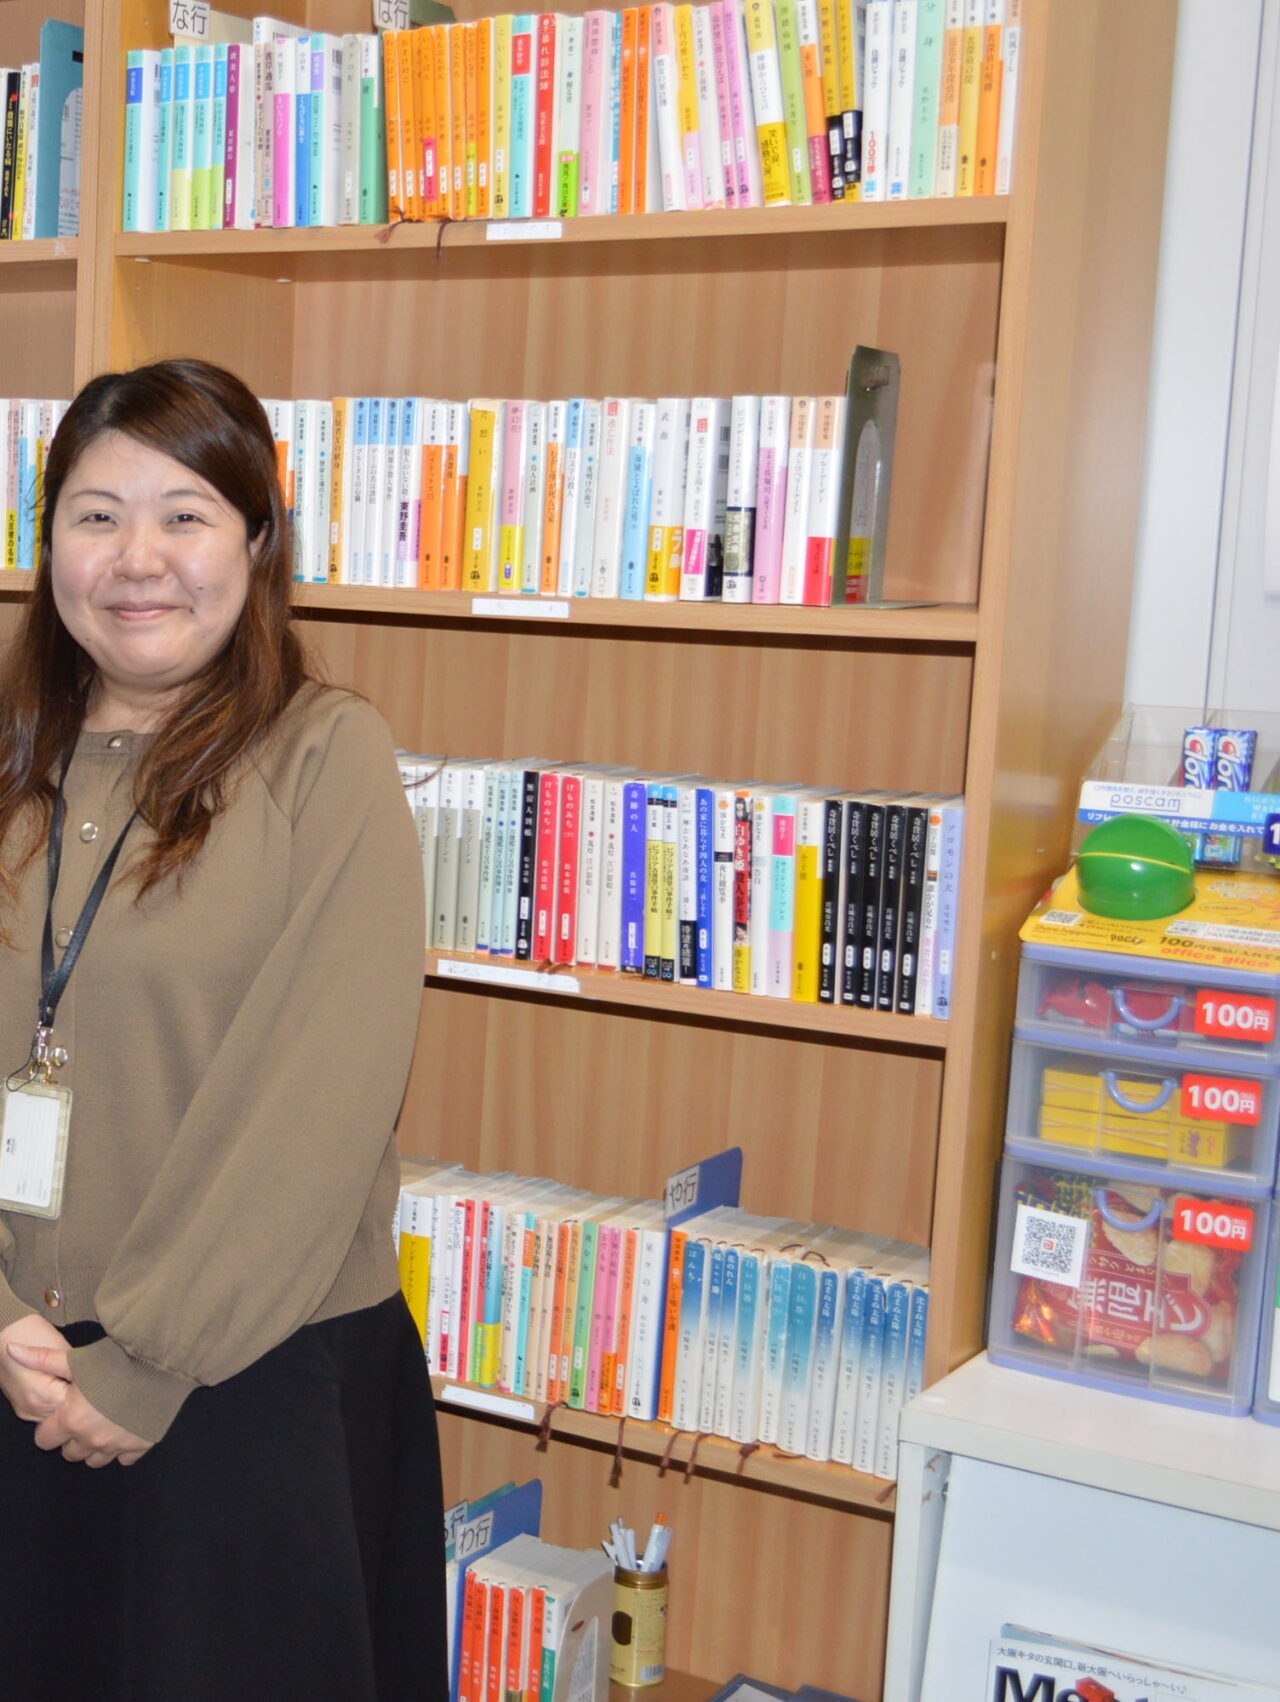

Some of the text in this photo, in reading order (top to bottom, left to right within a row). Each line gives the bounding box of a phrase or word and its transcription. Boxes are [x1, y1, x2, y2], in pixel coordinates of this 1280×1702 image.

[173, 2, 208, 35] な行
[399, 501, 410, 542] 東野圭吾
[1185, 734, 1206, 791] Clor
[1217, 735, 1242, 793] Clor
[1111, 794, 1180, 811] poscam
[699, 798, 709, 883] あの家に暮らす四人の女
[1161, 947, 1270, 968] office glico
[1202, 1001, 1270, 1031] 100円
[1188, 1085, 1256, 1113] 100円
[669, 1172, 698, 1211] や行
[1180, 1209, 1247, 1241] 100円
[459, 1518, 492, 1557] わ行
